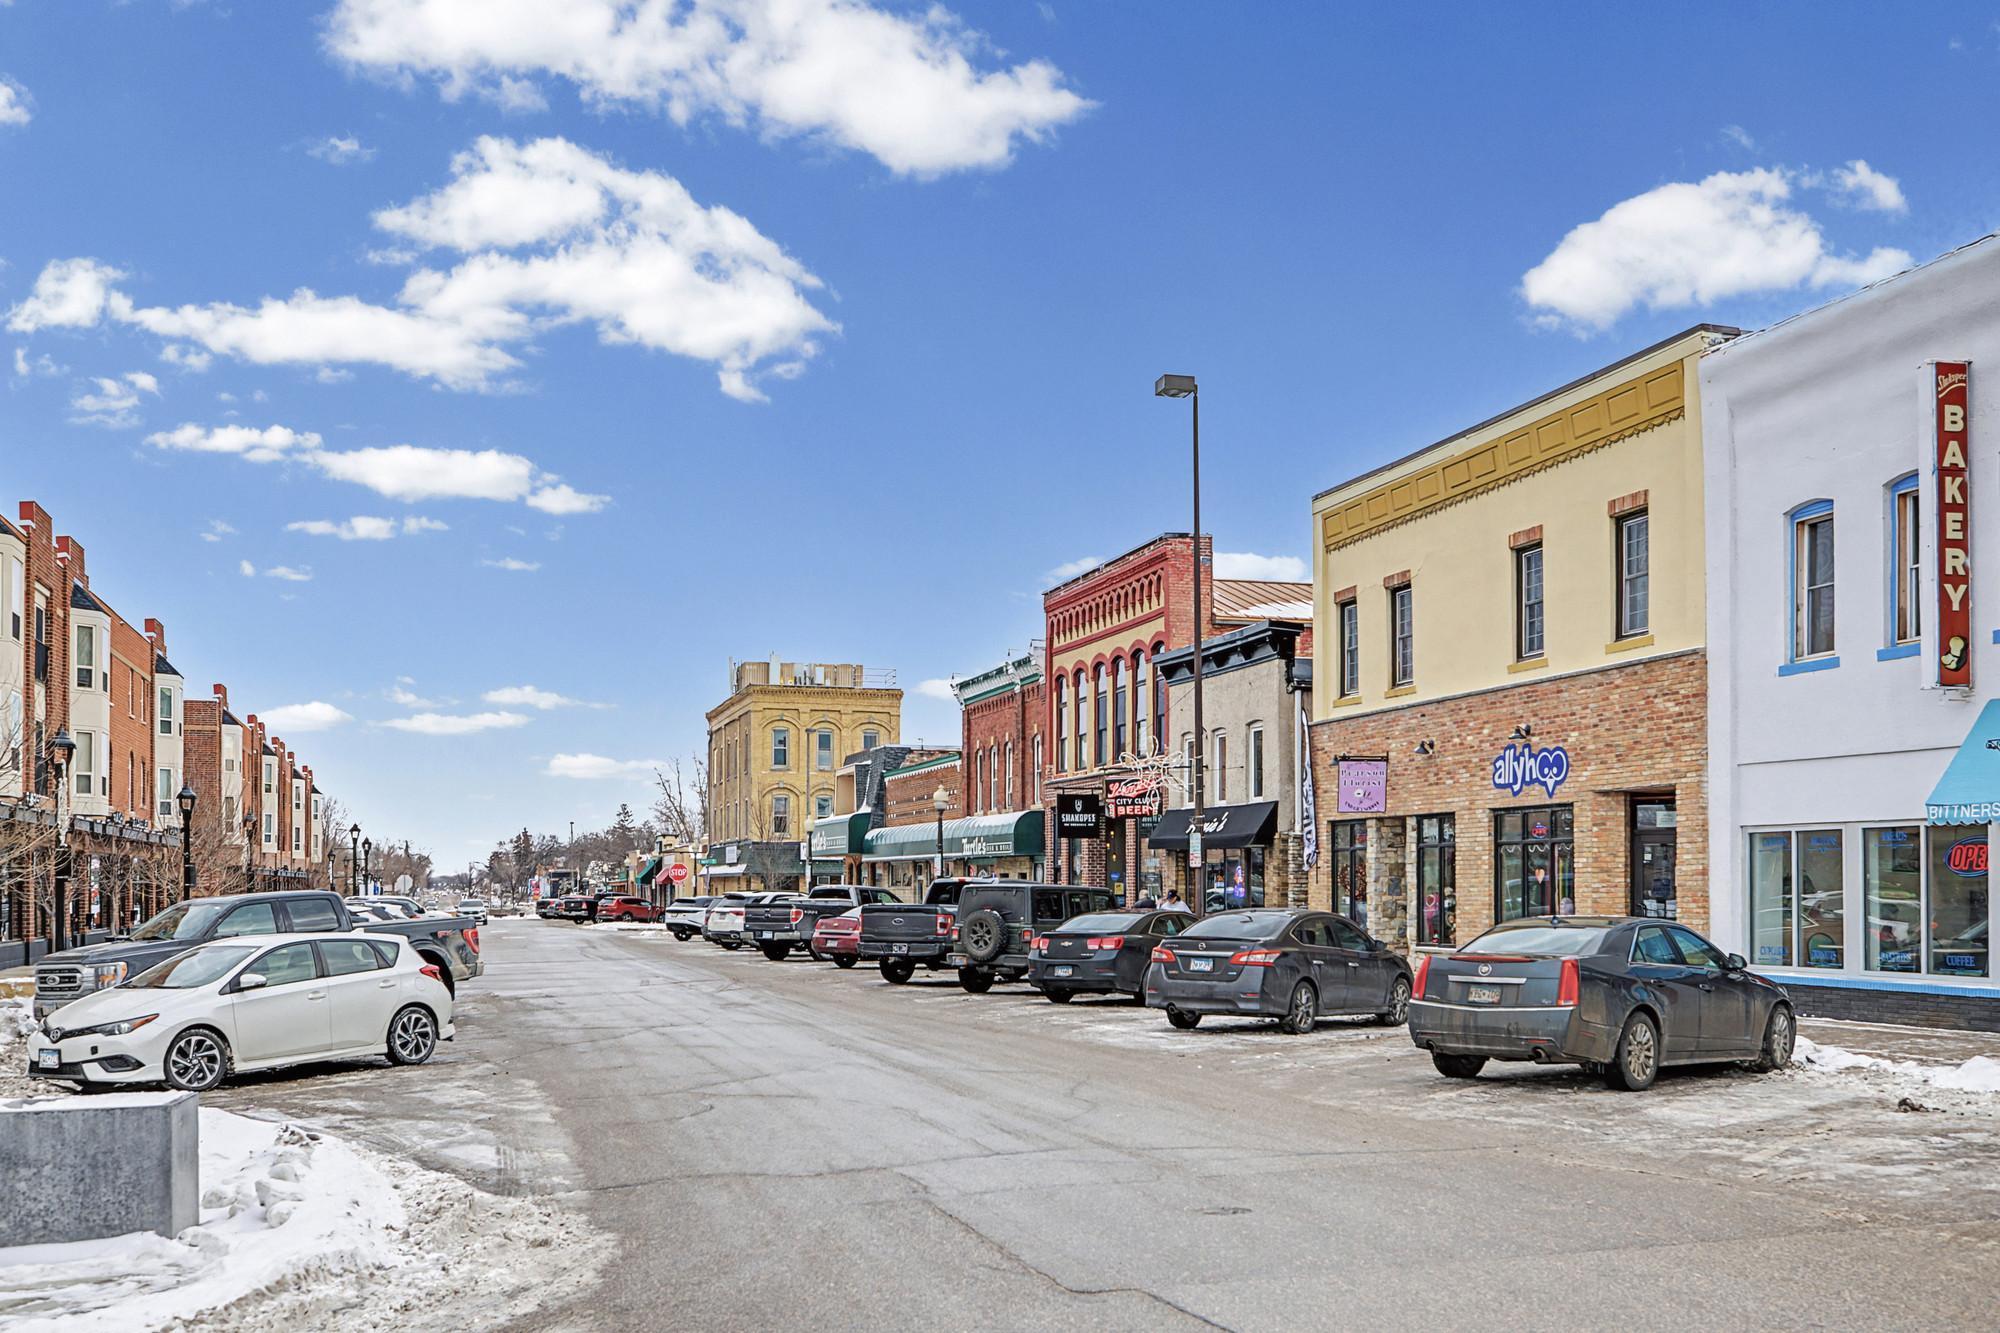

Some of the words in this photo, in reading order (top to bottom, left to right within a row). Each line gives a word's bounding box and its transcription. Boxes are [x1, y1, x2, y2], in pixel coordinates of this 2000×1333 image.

[1943, 404, 1968, 612] BAKERY
[1117, 805, 1150, 816] BEER
[1928, 802, 2000, 819] BITTNERS
[1061, 813, 1096, 822] SHAKOPEE
[961, 836, 986, 855] Turtle's
[671, 868, 687, 876] STOP
[1945, 955, 1976, 966] COFFEE
